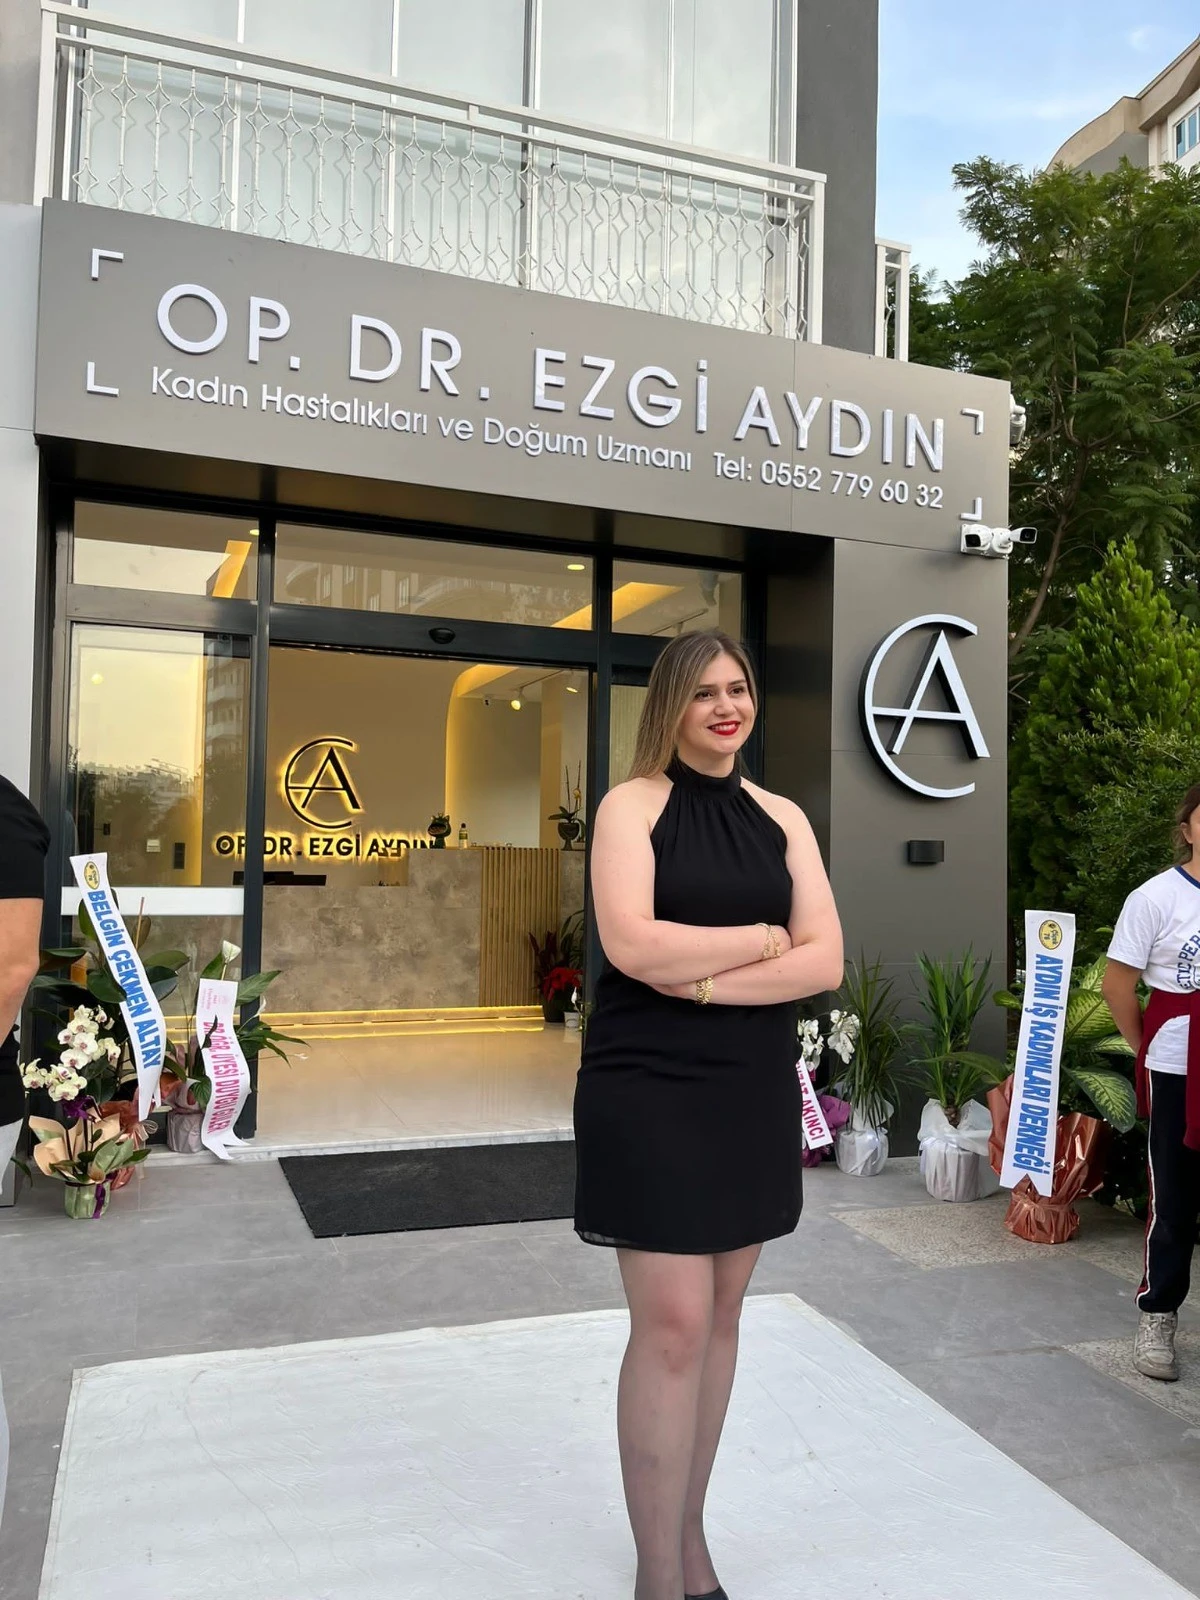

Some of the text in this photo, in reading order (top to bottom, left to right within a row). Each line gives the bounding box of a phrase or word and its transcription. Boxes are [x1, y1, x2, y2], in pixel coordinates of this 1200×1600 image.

[156, 283, 944, 472] OP. DR. EZGİ AYDIN
[152, 366, 944, 509] Kadın Hastalıkları ve Doğum Uzmanı Tel: 0552 779 60 32
[308, 834, 362, 857] EZGİ
[87, 890, 161, 1069] BELGİN ÇEKMEN ALTAY
[211, 1053, 245, 1079] ÜYESİ
[214, 1079, 240, 1109] DUYGU
[1013, 953, 1065, 1176] AYDIN İŞ KADINLARI DERNEĞİ
[801, 1099, 826, 1141] AKINCI
